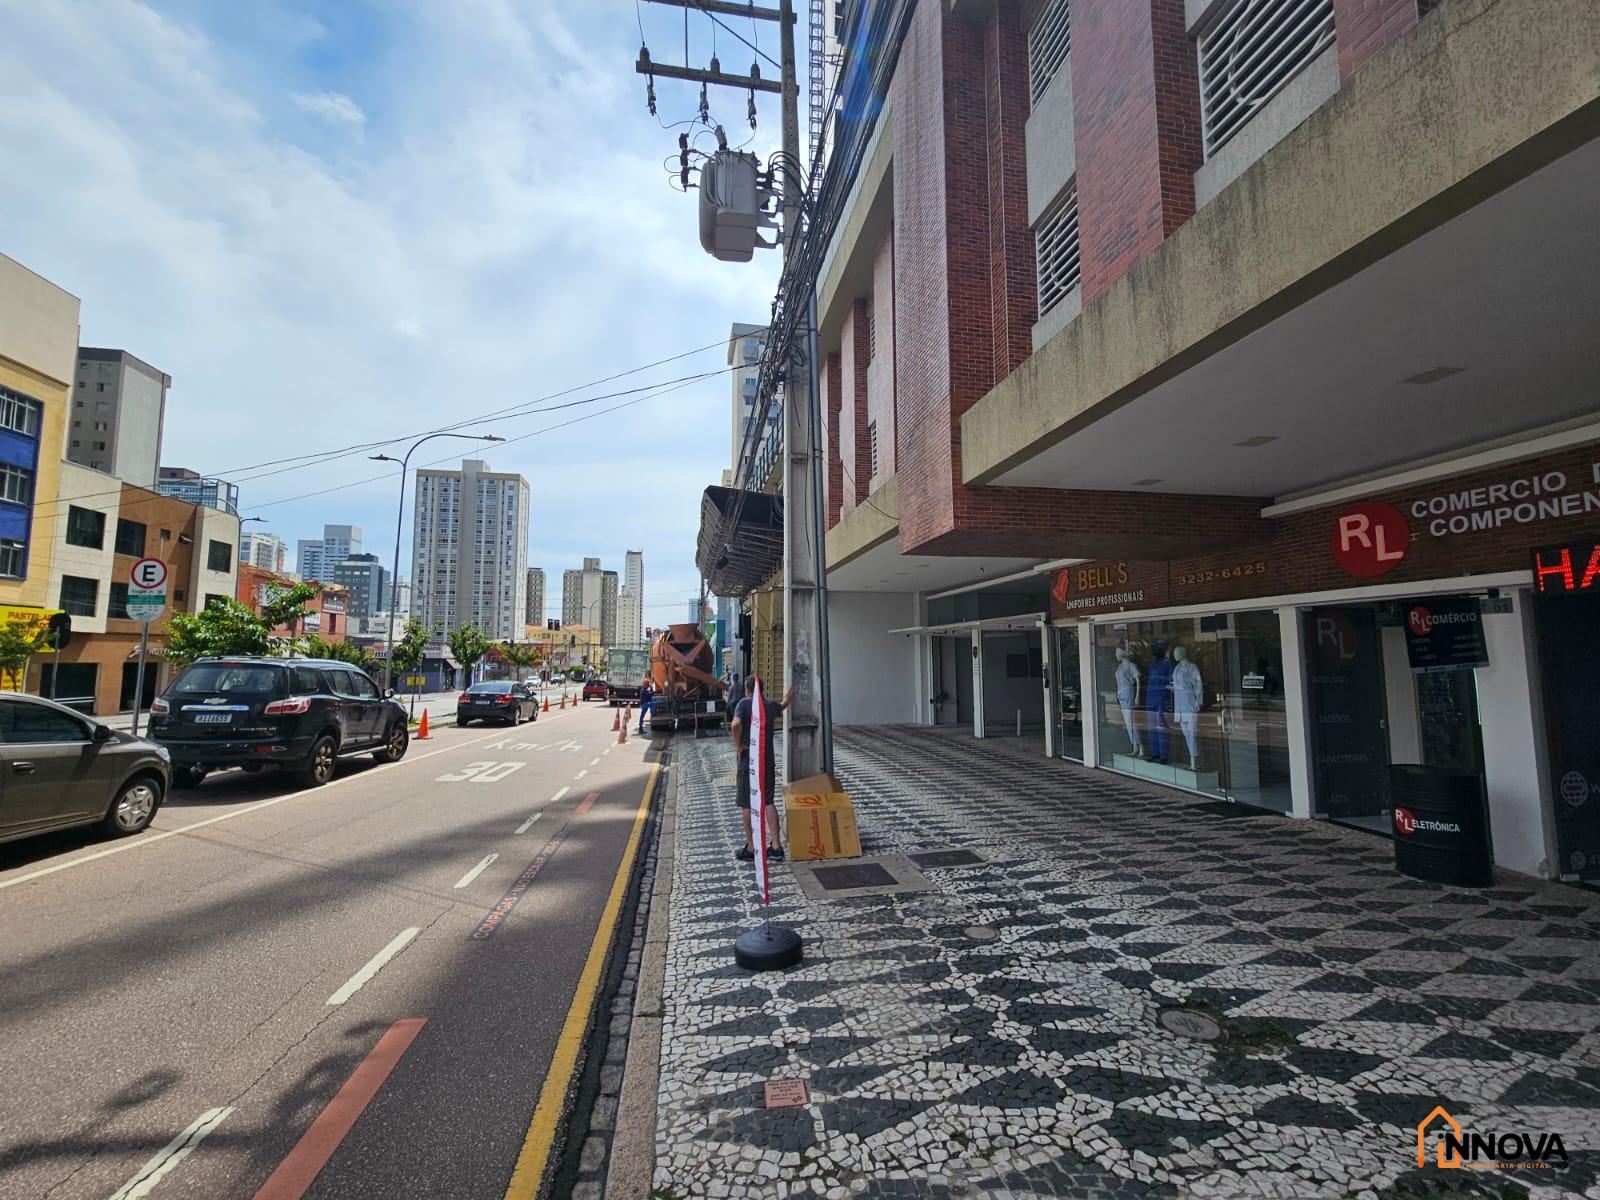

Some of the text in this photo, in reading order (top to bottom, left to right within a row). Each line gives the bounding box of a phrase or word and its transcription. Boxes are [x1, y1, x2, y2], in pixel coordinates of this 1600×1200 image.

[1411, 471, 1567, 518] COMERCIO
[1339, 513, 1404, 561] RL
[142, 564, 157, 582] E
[1178, 562, 1266, 585] 3232-6425
[1066, 590, 1144, 610] UNIFORMES PROFISSIONAIS
[434, 760, 528, 783] 30
[1412, 820, 1460, 833] ELETRÔNICA
